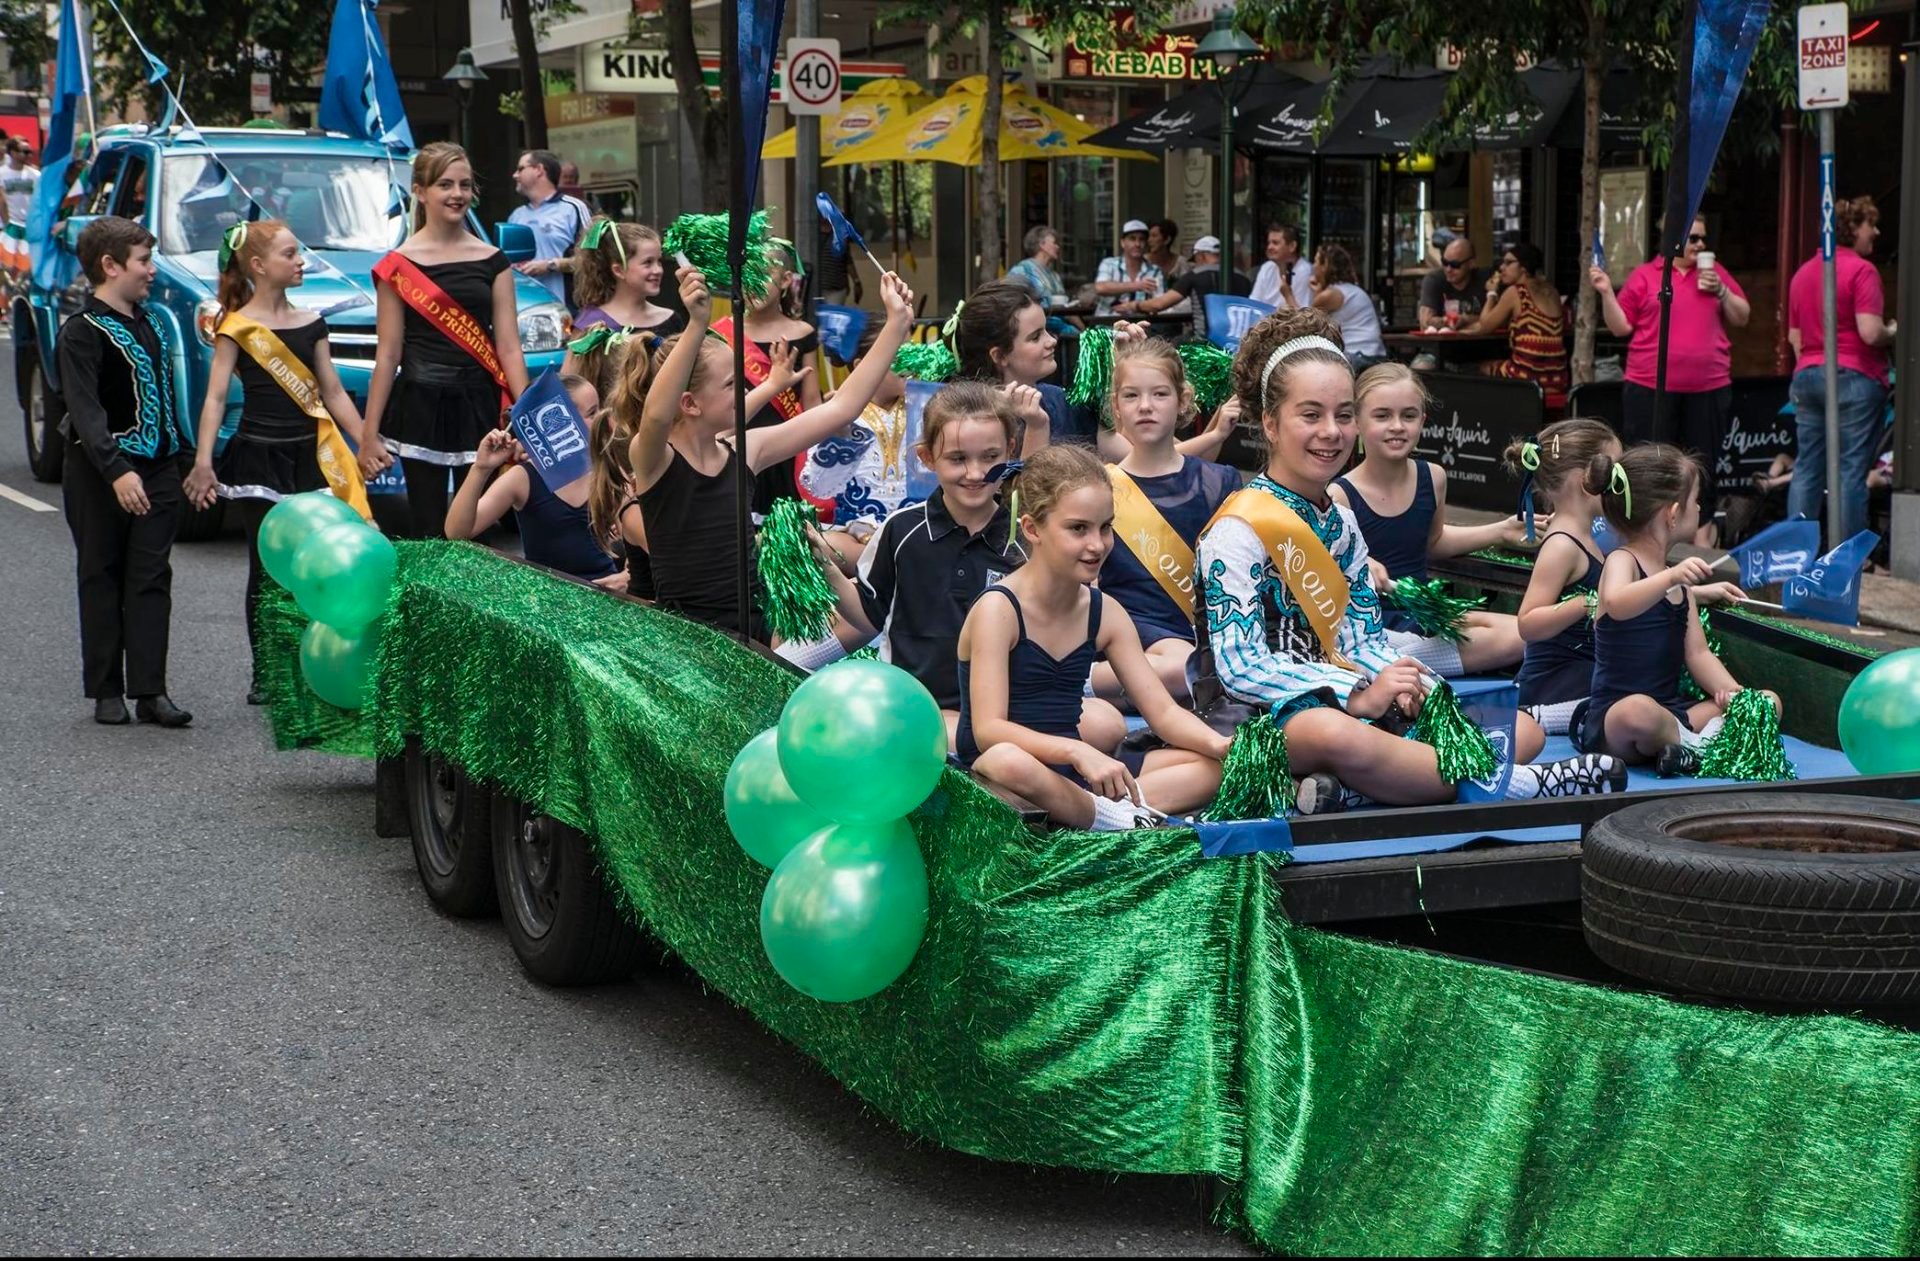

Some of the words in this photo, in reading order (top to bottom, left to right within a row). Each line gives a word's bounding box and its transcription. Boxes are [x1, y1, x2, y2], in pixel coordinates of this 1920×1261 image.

[1802, 53, 1845, 68] ZONE
[1805, 38, 1843, 52] TAXI
[795, 63, 832, 89] 40
[1092, 52, 1186, 78] KEBAB
[1821, 158, 1834, 257] TAXI
[1446, 410, 1490, 448] Squire
[1722, 416, 1792, 454] Squire
[1159, 553, 1192, 594] QLD
[1302, 571, 1337, 617] QLD
